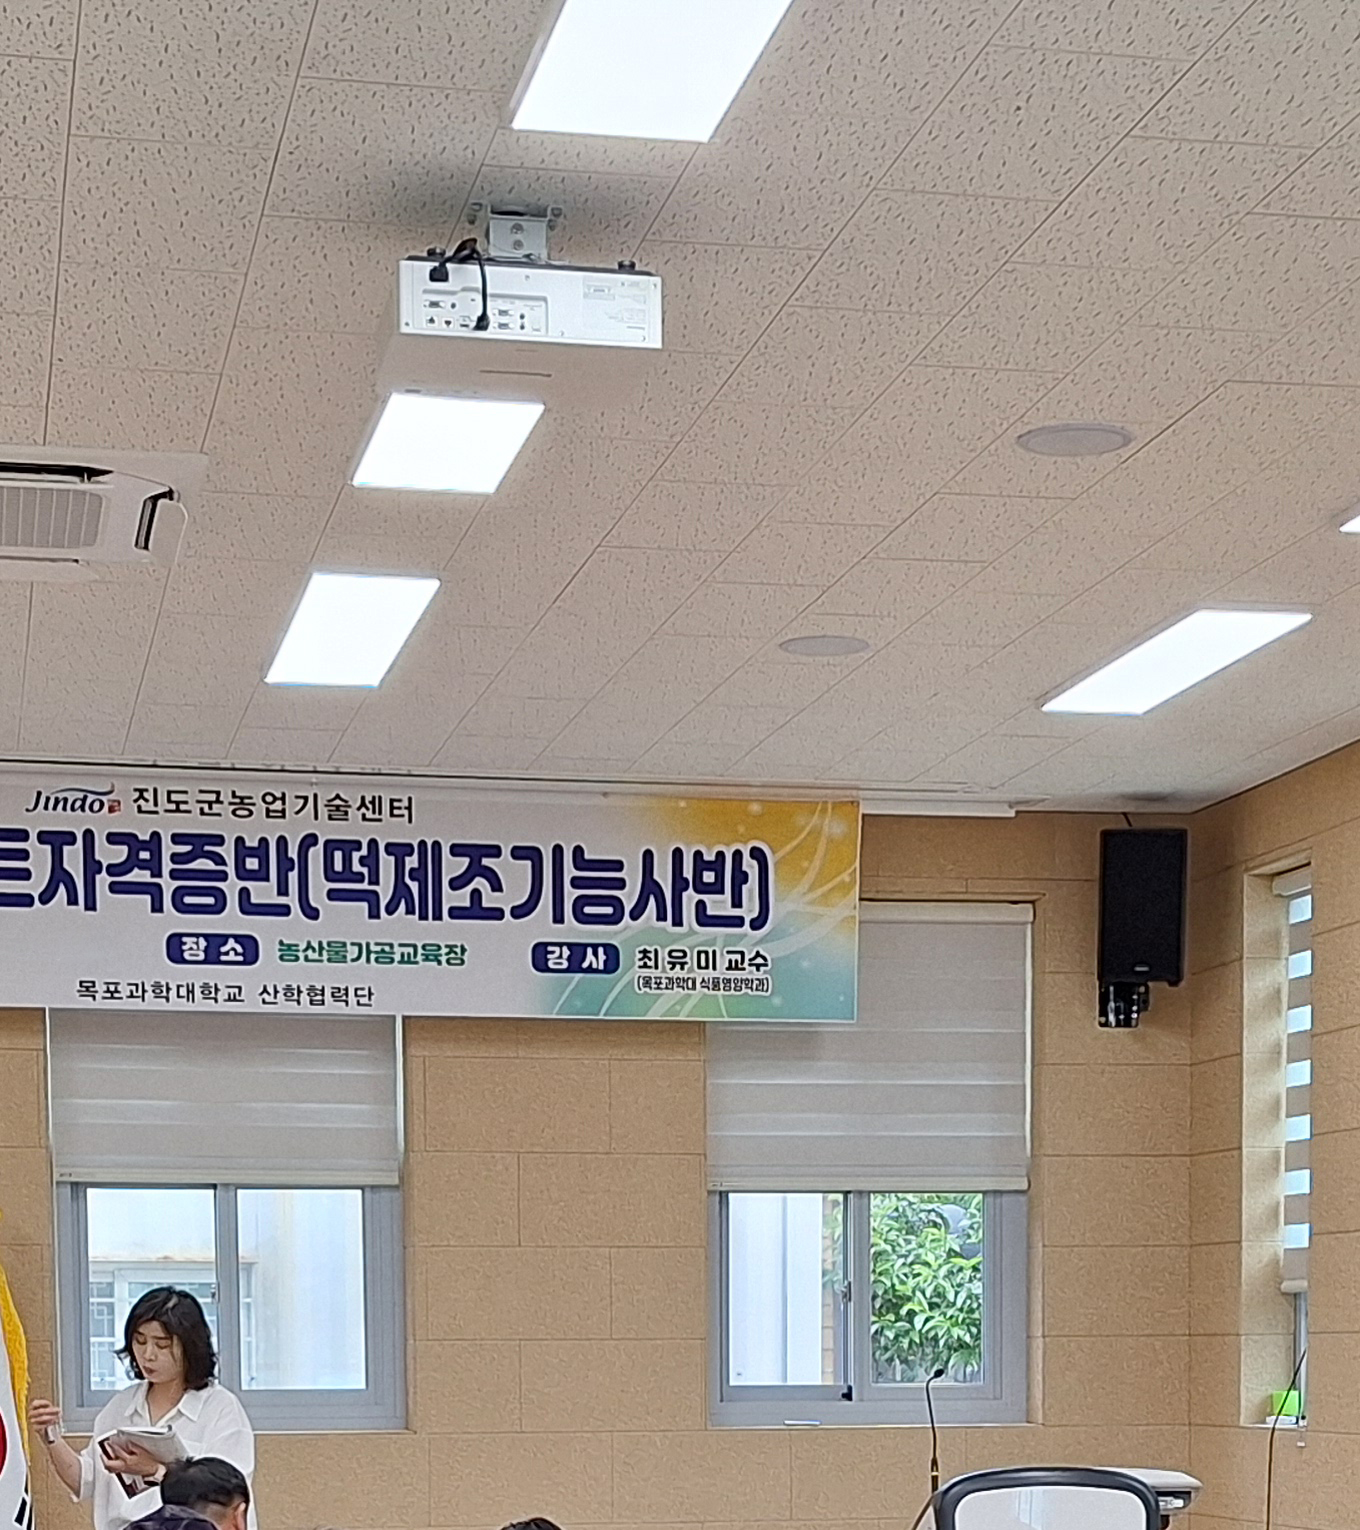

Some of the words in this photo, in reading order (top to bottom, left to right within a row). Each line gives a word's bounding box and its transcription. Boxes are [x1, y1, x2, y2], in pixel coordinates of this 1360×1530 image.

[25, 787, 106, 814] Jindo
[133, 786, 414, 824] 진도군농업기술센터
[277, 939, 468, 966] 농산물가공교육장
[76, 980, 246, 1004] 목포과학대학교
[257, 983, 375, 1008] 산학협력단
